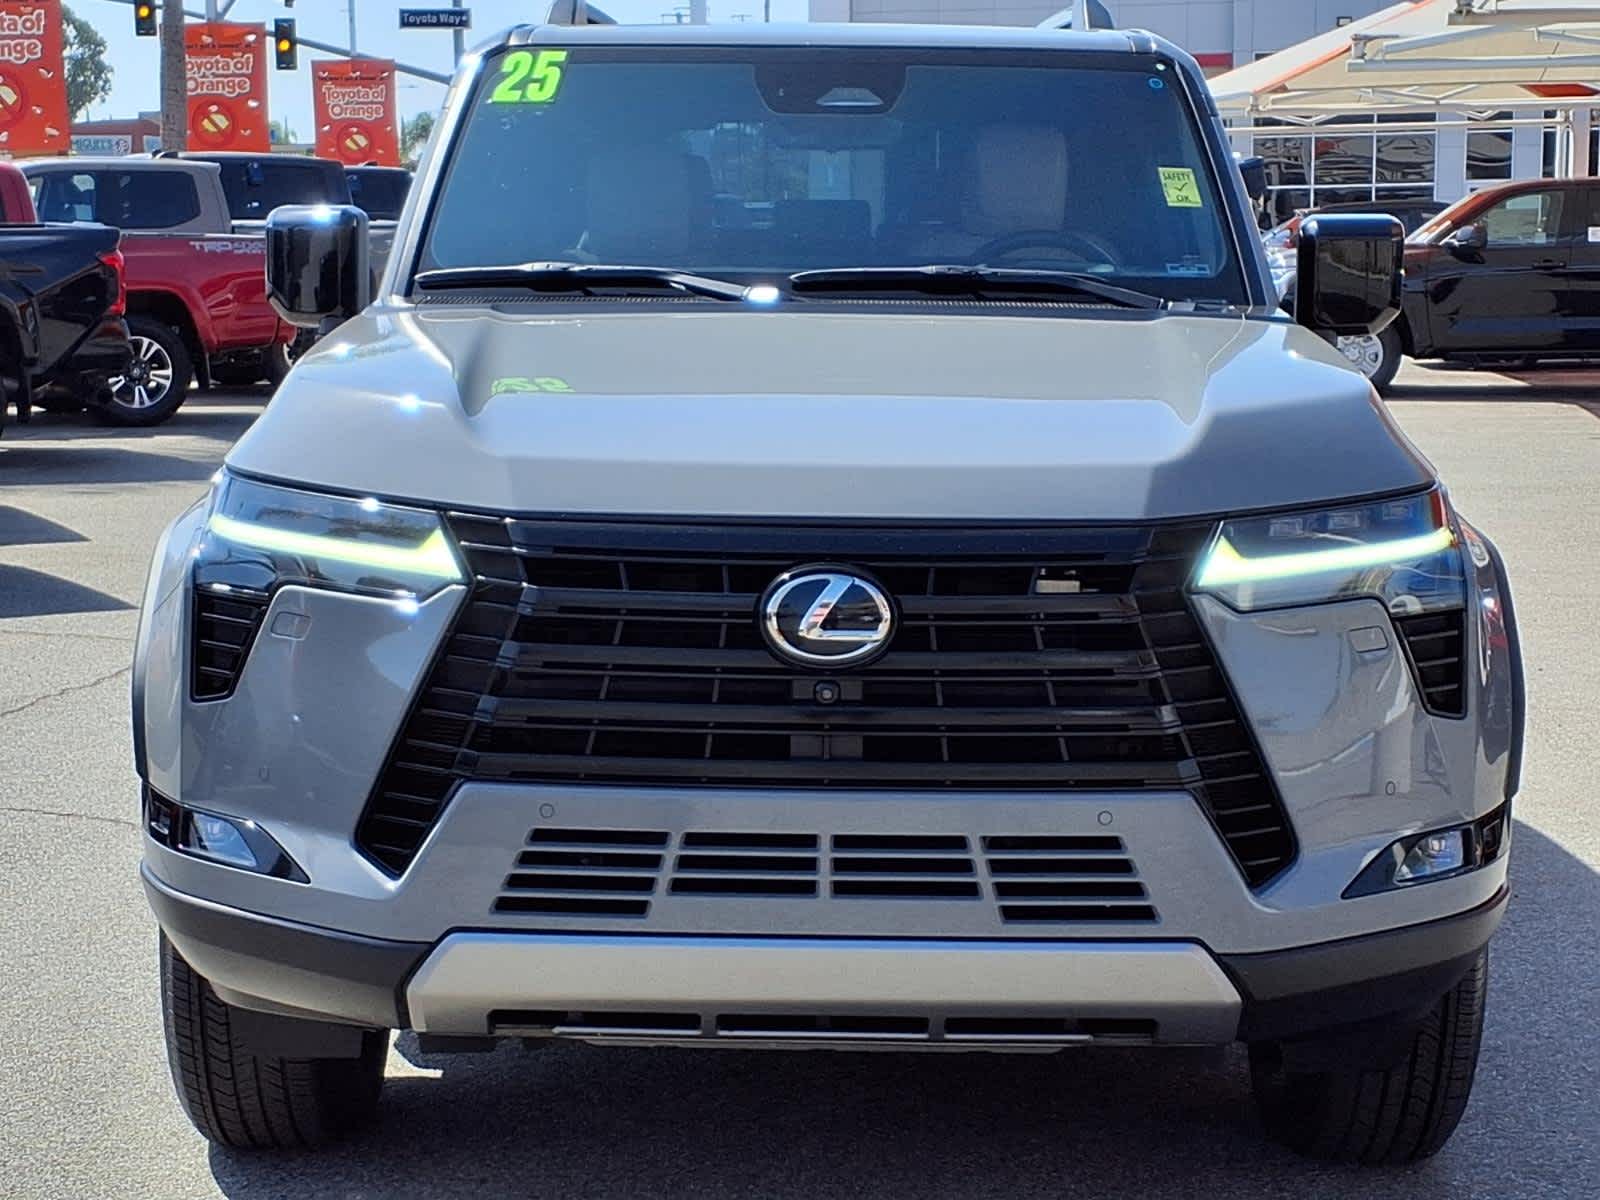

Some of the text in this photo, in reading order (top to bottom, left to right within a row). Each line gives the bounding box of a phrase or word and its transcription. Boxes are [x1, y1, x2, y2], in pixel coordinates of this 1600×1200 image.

[403, 13, 461, 25] Toyota Way
[184, 53, 254, 76] oyota of
[491, 50, 568, 102] 25
[322, 84, 386, 104] Toyota of
[328, 103, 385, 120] Orange
[1162, 171, 1191, 181] SAFETY
[189, 241, 232, 253] TRD
